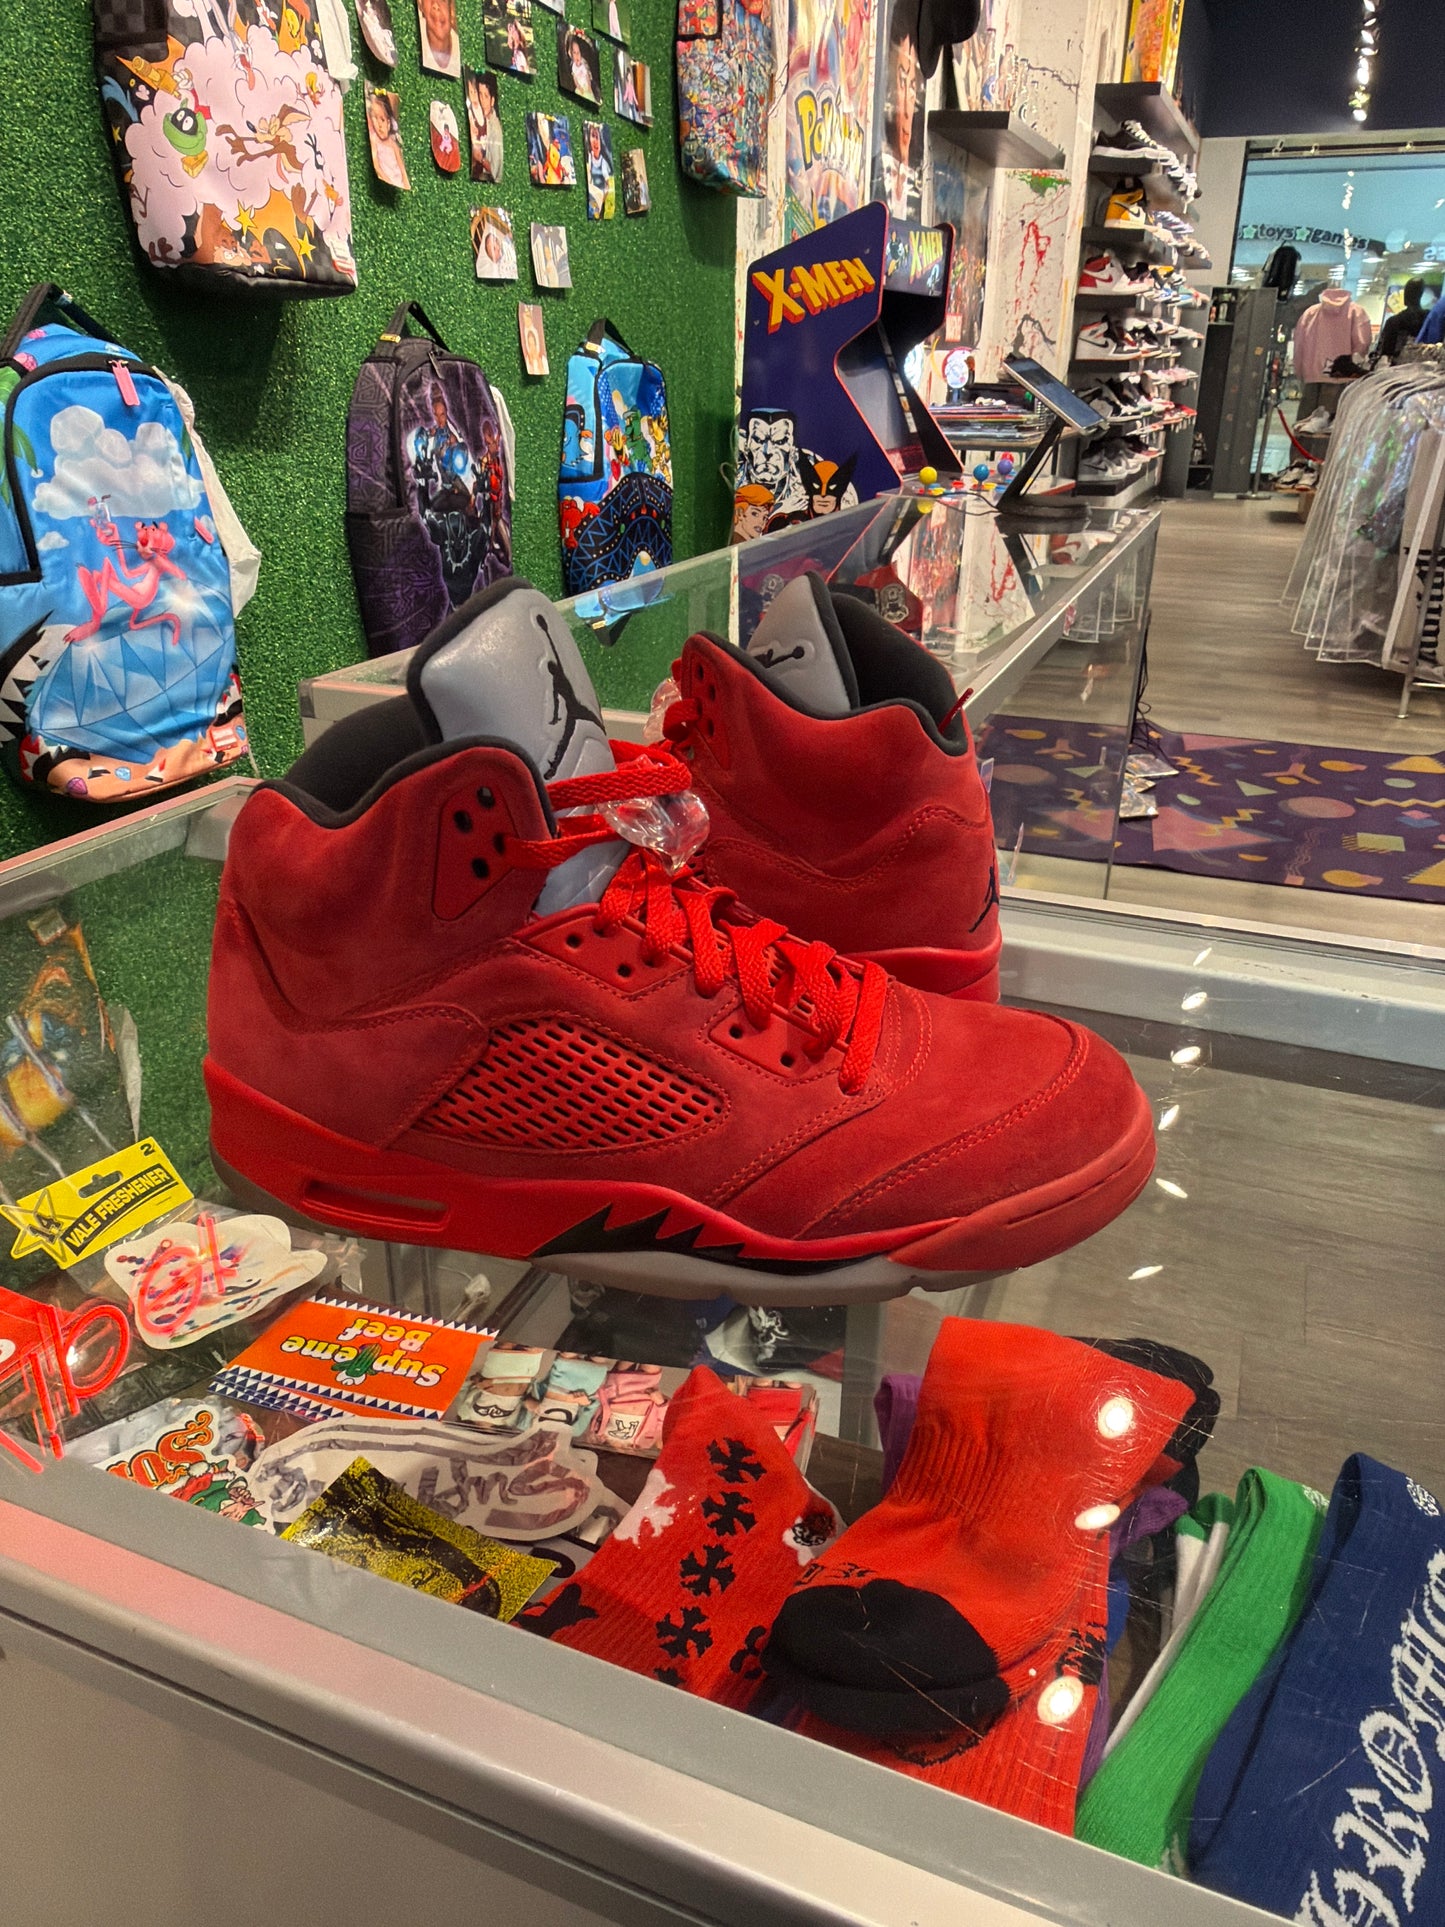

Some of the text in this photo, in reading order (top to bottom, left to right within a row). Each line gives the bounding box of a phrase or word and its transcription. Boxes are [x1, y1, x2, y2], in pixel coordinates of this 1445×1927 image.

[909, 231, 944, 284] X-MEN
[1258, 223, 1294, 240] toys
[752, 257, 876, 335] X-MEN
[140, 1143, 155, 1157] 2
[65, 1167, 171, 1248] VALE FRESHENER
[337, 1317, 434, 1352] Beef
[280, 1335, 448, 1387] Supeme
